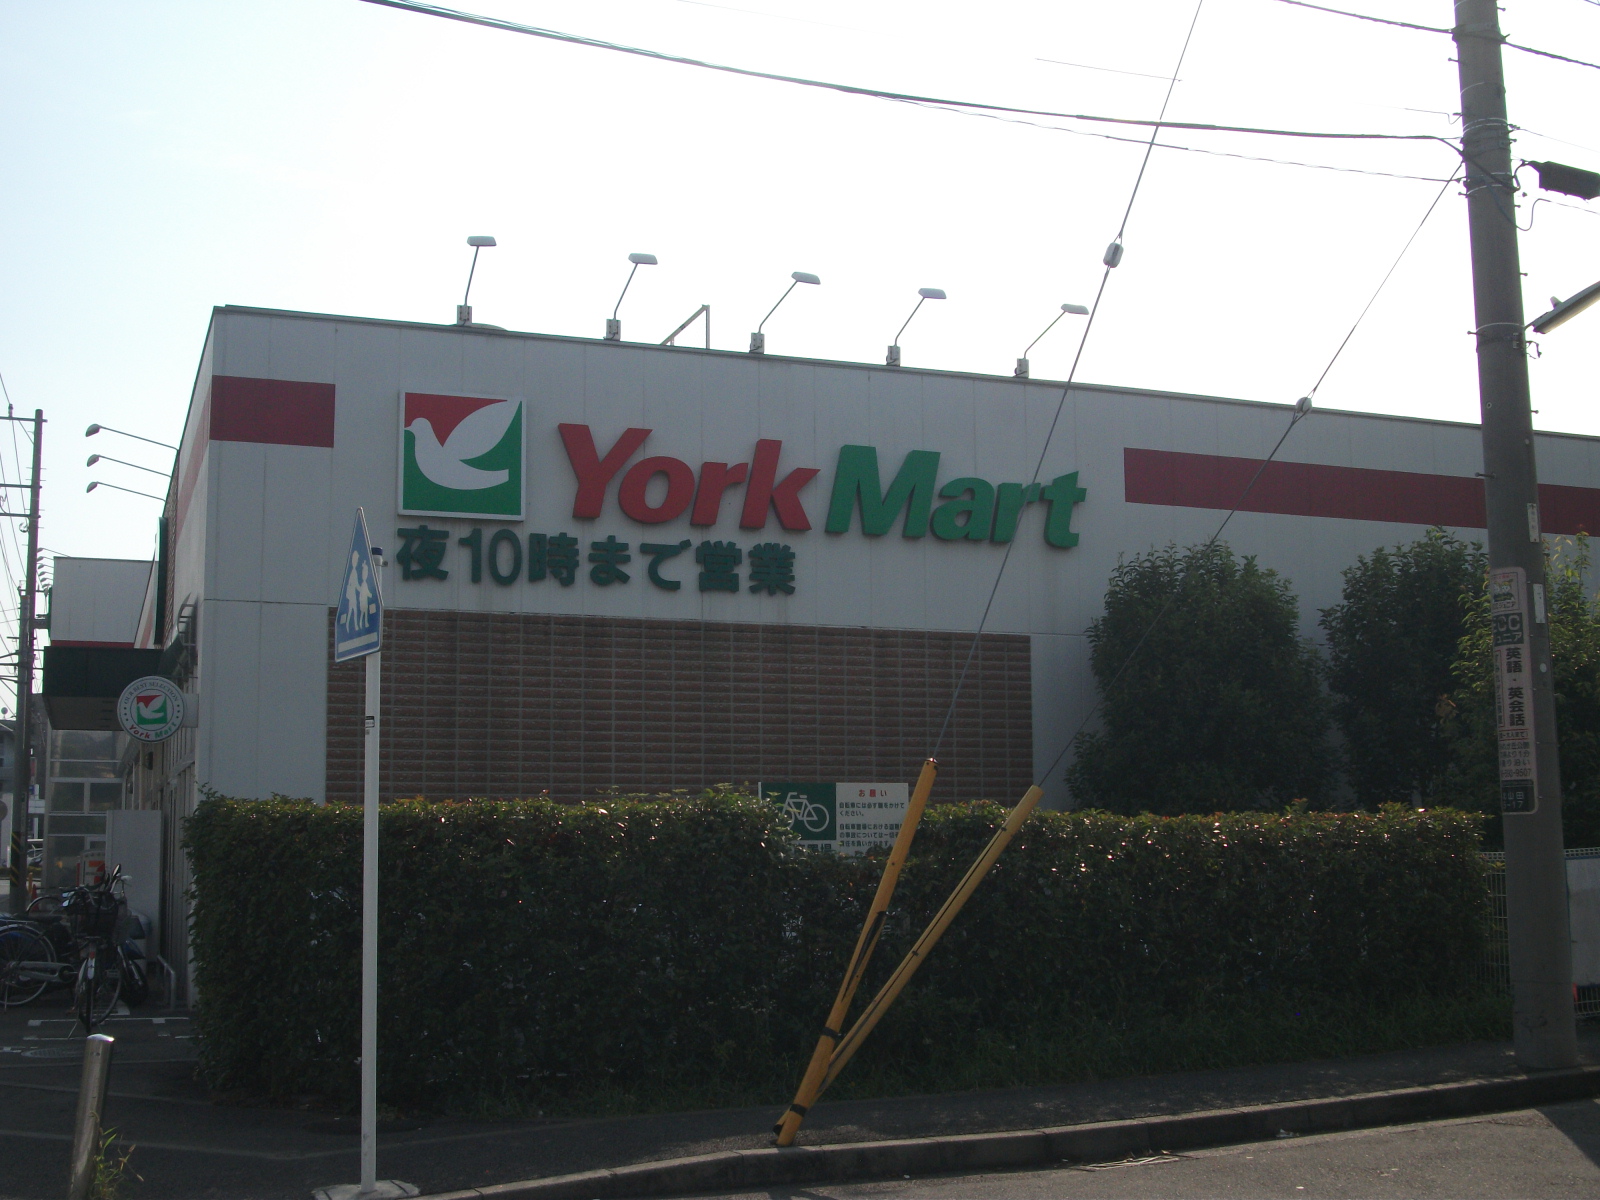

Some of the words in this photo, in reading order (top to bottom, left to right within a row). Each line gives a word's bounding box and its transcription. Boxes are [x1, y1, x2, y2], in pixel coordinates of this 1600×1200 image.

[558, 423, 821, 531] York
[825, 444, 1087, 548] Mart
[396, 524, 797, 595] 夜10時まで営業
[1505, 647, 1525, 727] 英語・英会話
[129, 724, 150, 739] York
[154, 721, 177, 739] Mart
[858, 788, 888, 798] お願い
